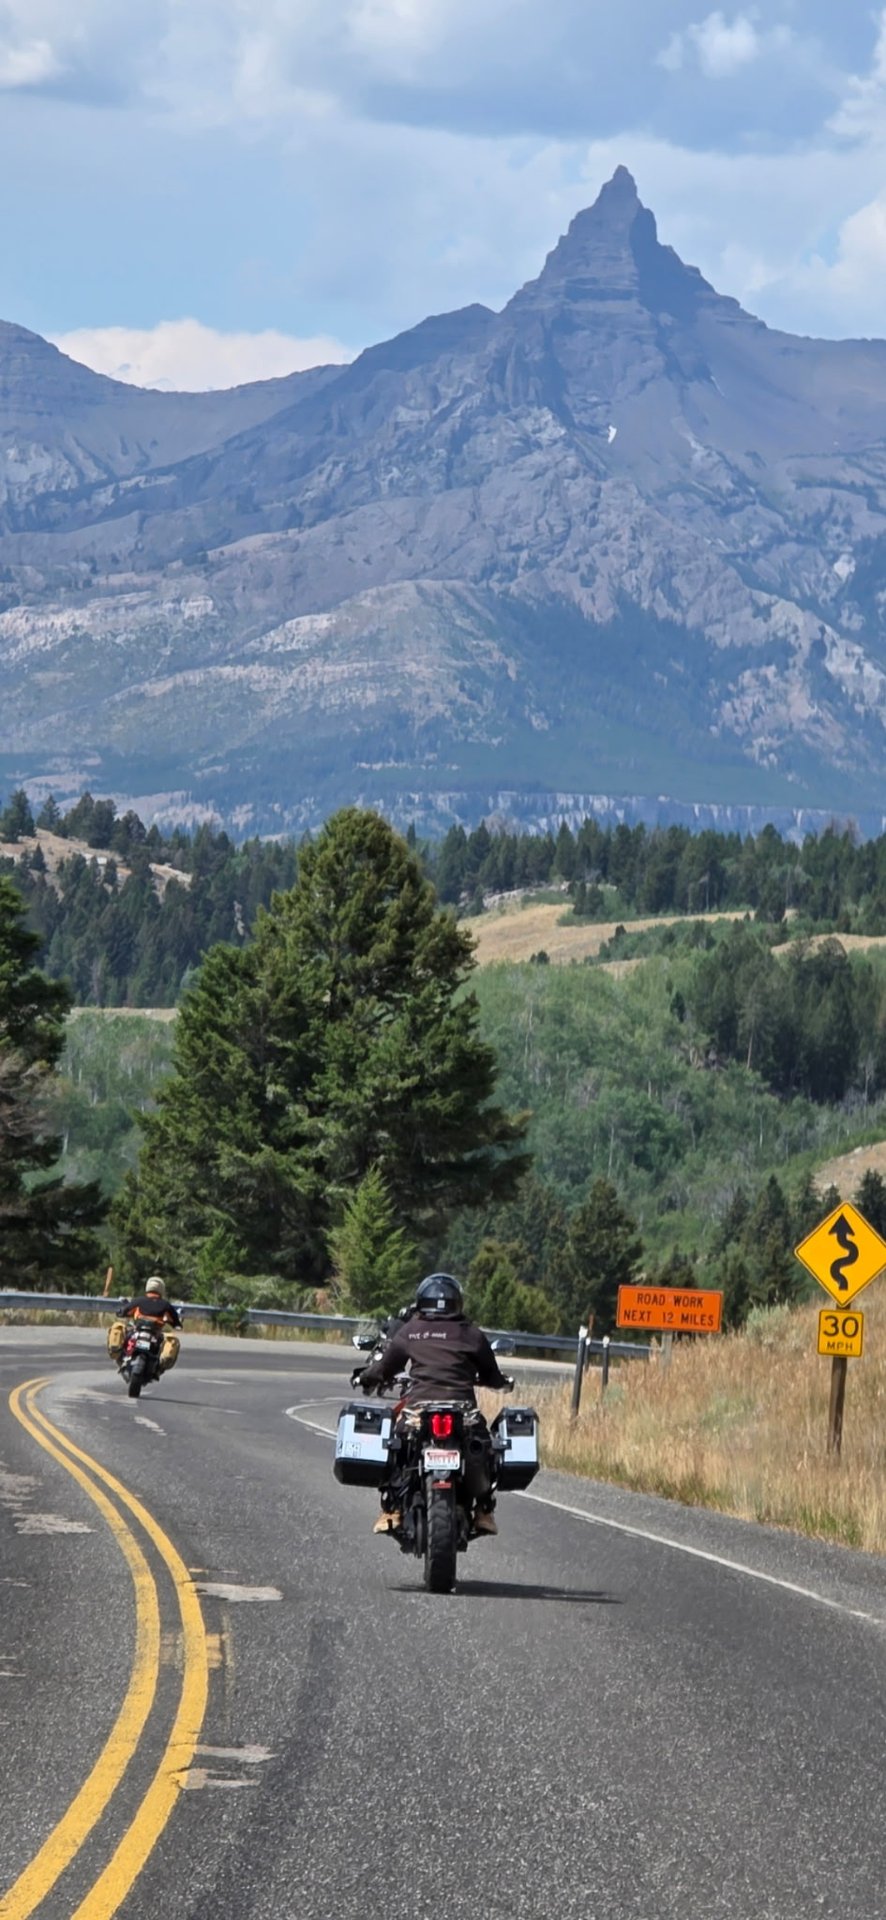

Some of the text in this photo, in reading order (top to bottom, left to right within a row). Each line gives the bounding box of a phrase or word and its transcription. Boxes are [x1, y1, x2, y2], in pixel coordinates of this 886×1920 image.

[636, 1293, 704, 1308] ROAD WORK
[623, 1309, 714, 1327] NEXT 12 MILES
[823, 1315, 859, 1338] 30
[826, 1341, 853, 1351] MPH
